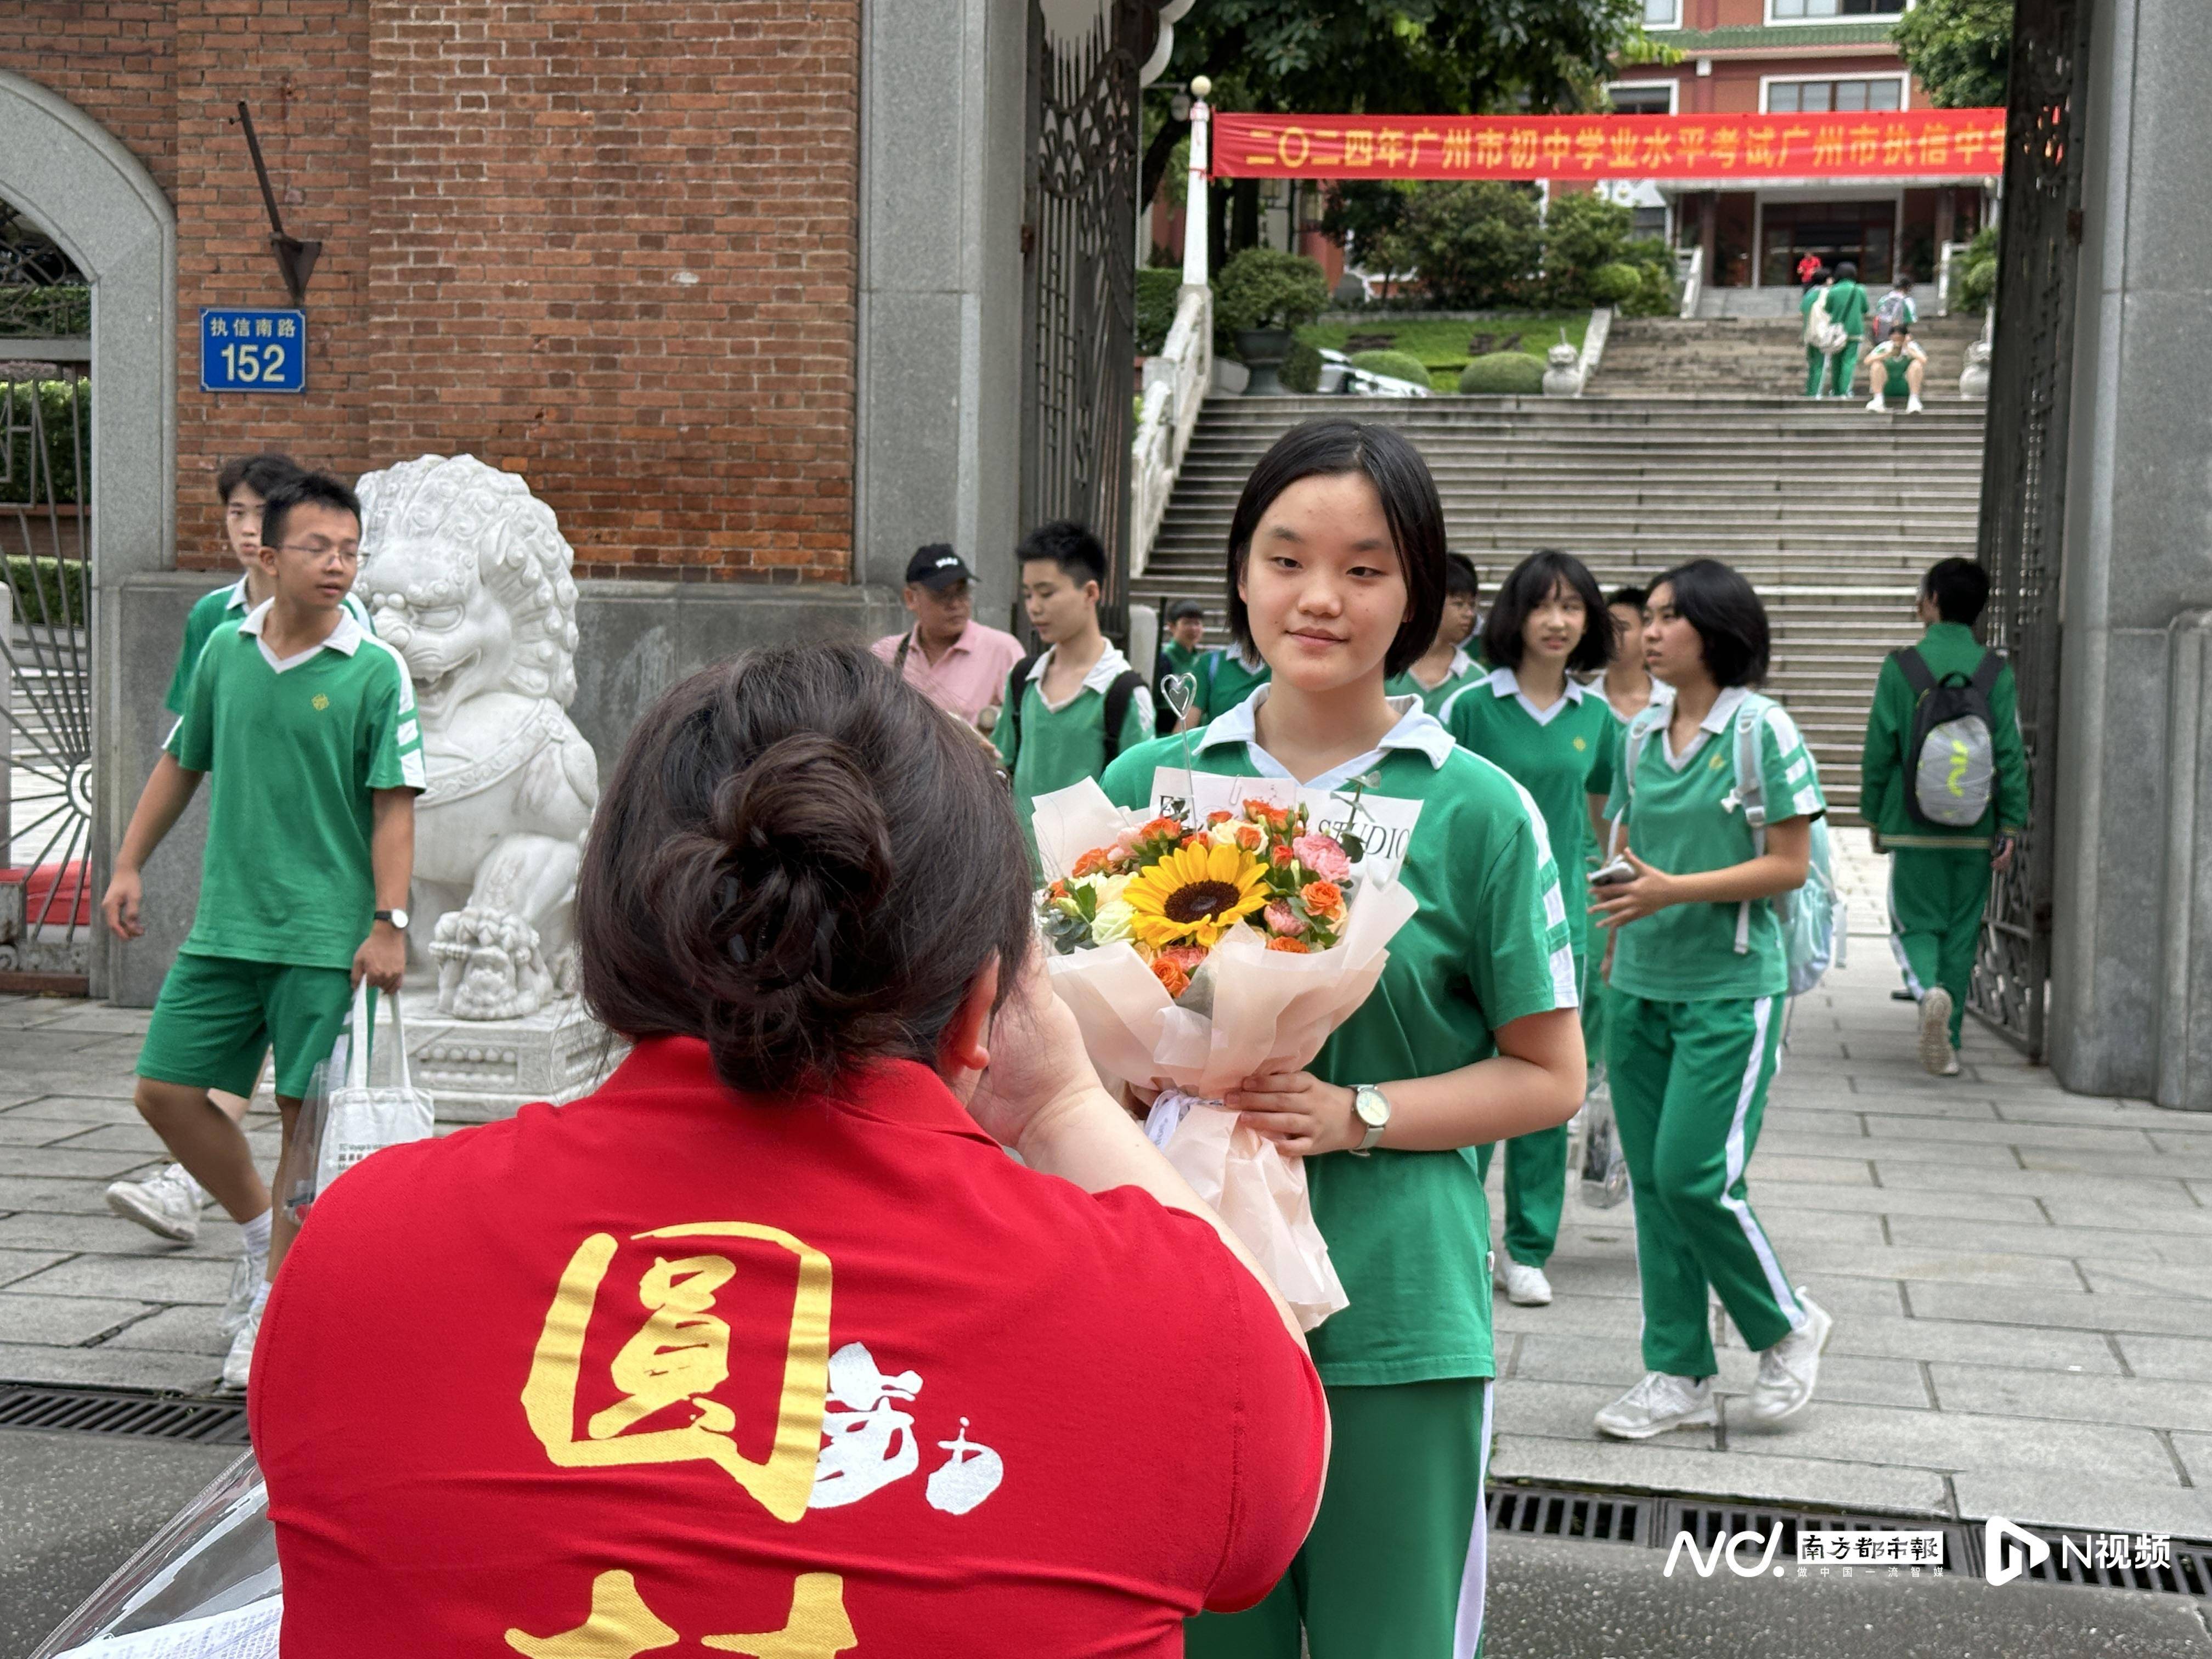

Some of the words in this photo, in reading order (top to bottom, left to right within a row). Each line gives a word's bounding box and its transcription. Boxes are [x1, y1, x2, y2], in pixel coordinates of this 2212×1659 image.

[210, 317, 296, 338] 执信南路
[221, 342, 285, 382] 152
